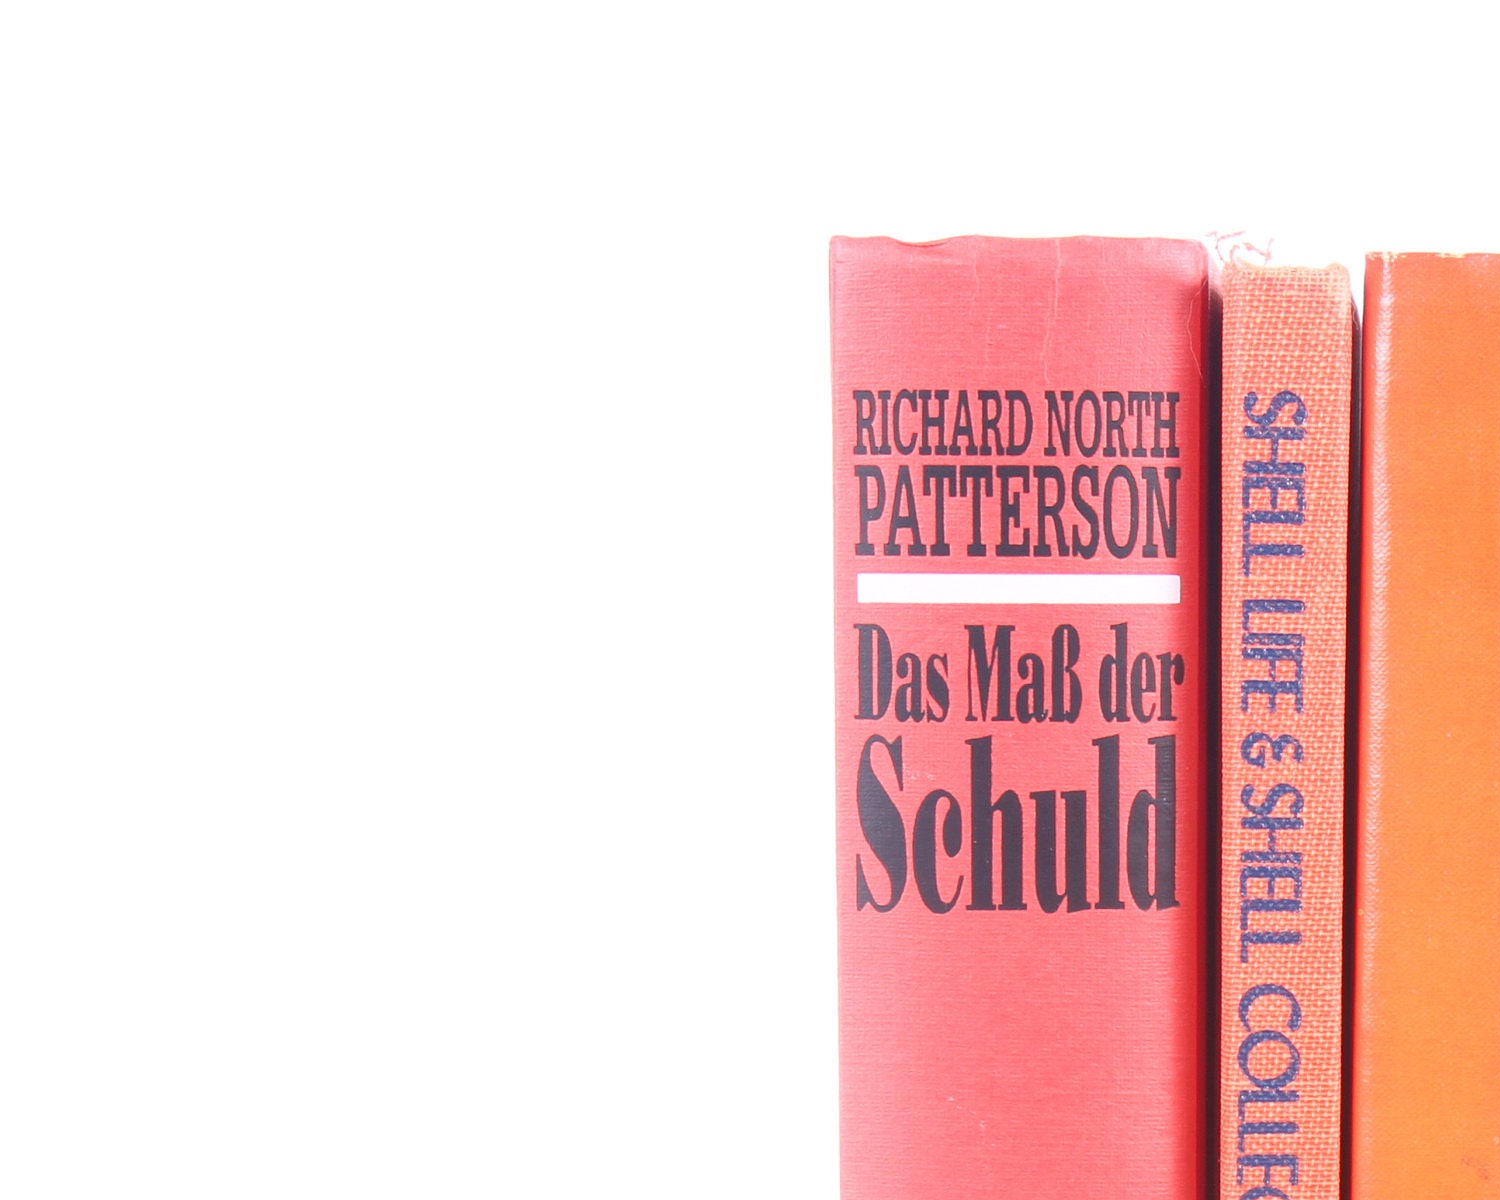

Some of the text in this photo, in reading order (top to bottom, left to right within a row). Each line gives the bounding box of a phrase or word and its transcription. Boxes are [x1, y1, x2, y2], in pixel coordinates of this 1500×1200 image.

[853, 389, 1180, 458] RICHARD NORTH
[855, 464, 1181, 559] PATTERSON
[1242, 390, 1307, 576] SHELL
[854, 622, 1185, 723] Das Maß der
[1241, 599, 1306, 713] LIFE
[1240, 731, 1304, 768] &
[856, 734, 1180, 912] Schuld
[1239, 783, 1304, 963] SHELL
